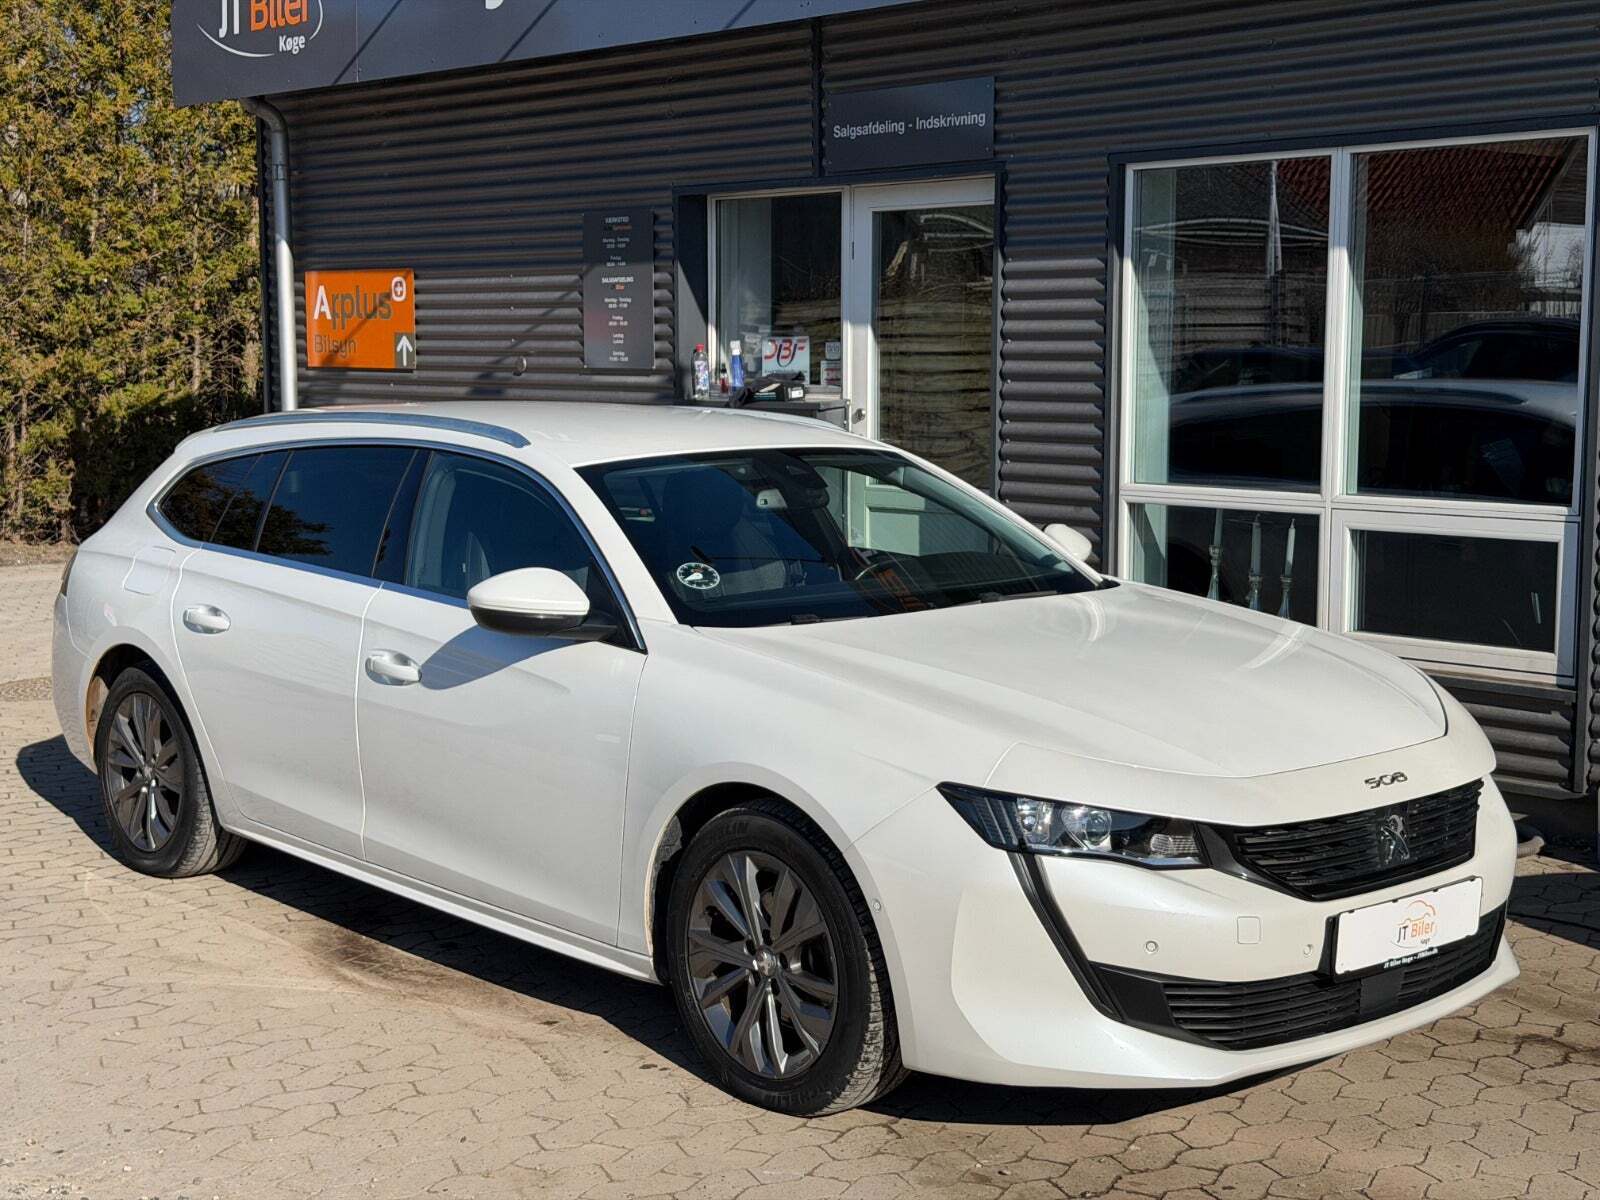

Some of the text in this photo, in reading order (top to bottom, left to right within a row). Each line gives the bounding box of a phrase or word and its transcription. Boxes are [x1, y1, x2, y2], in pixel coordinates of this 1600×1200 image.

[278, 35, 306, 54] Køge
[832, 119, 905, 139] Salgsafdeling
[915, 112, 986, 131] Indskrivning
[314, 334, 357, 358] Bilsyn
[1364, 771, 1408, 789] 508
[1396, 925, 1409, 943] JT
[1410, 919, 1434, 938] Biler
